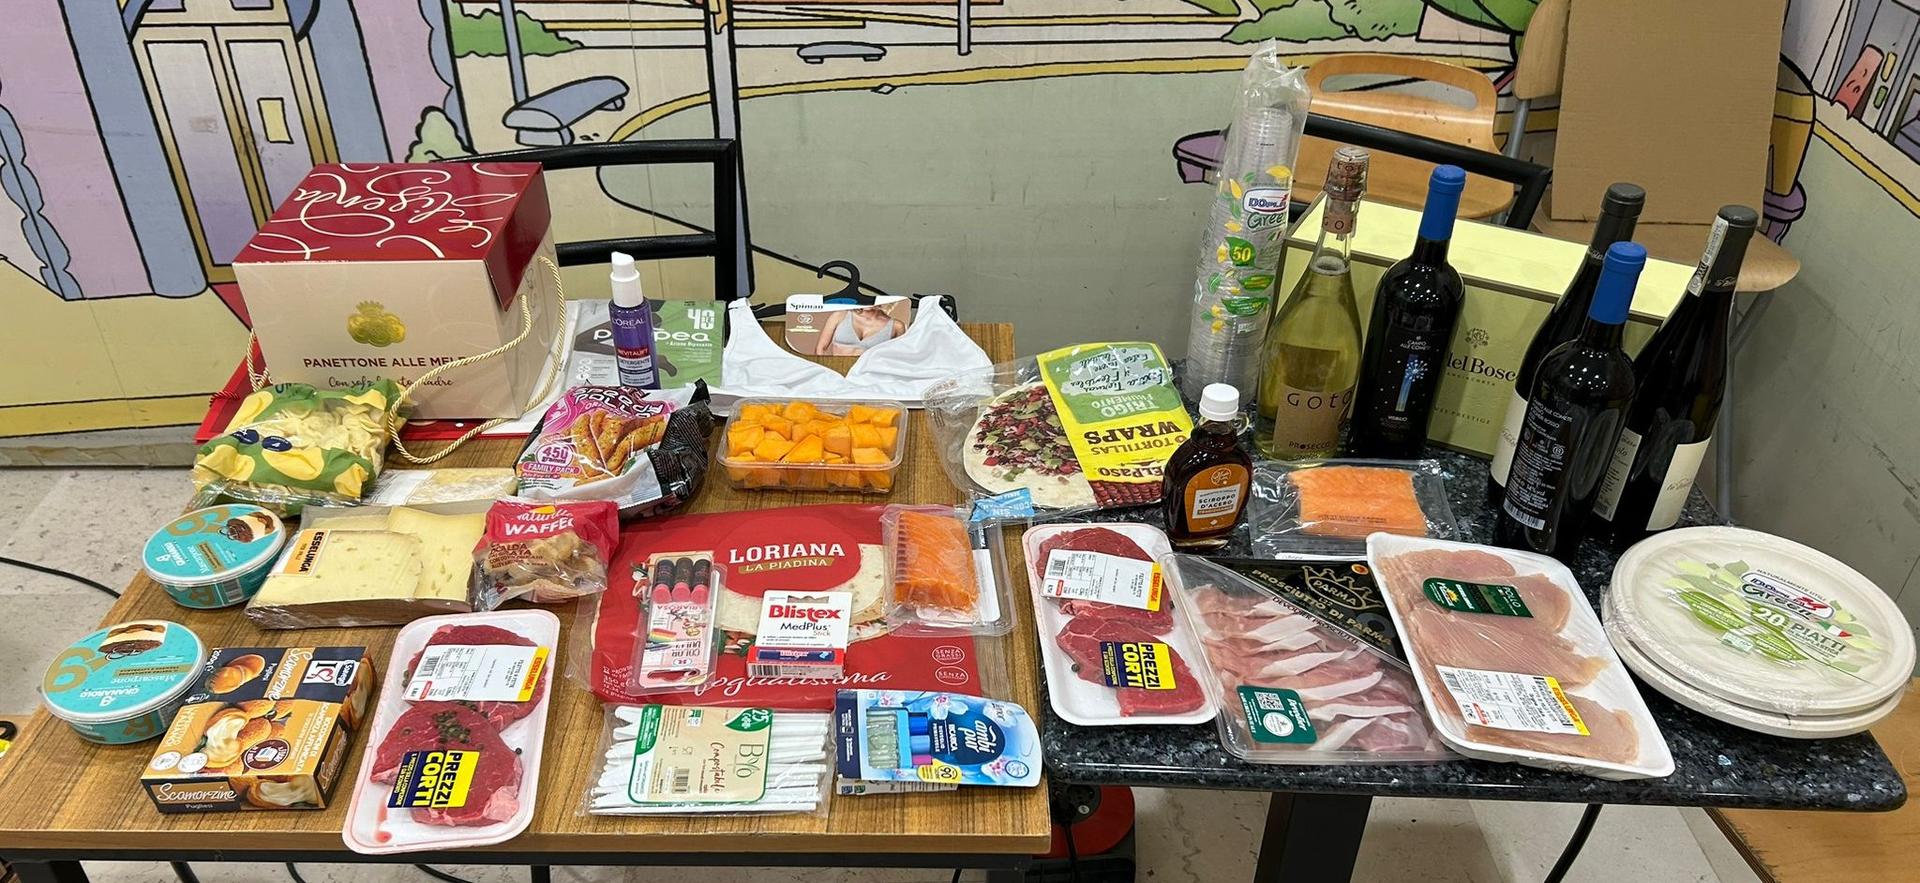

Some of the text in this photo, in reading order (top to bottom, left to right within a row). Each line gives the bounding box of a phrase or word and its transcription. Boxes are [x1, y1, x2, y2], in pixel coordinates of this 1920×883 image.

[1232, 247, 1252, 262] 50
[303, 358, 388, 368] PANETTONE
[392, 357, 427, 367] ALLE
[1092, 394, 1153, 409] FRUMENTO
[1101, 401, 1160, 417] TRIGO
[1084, 421, 1183, 445] WRAPS
[542, 445, 569, 459] 450
[1092, 438, 1173, 456] TORTILLAS
[1289, 440, 1330, 451] PROSECCO
[528, 463, 575, 474] FAMILY PACK
[1199, 494, 1236, 504] SCIROPPO
[1200, 500, 1233, 508] D'ACERO
[299, 531, 325, 572] ESSELUNGA
[729, 543, 846, 564] LORIANA
[745, 559, 828, 572] LA PIADINA
[1151, 572, 1161, 603] ESSELUNGA
[1313, 580, 1357, 606] PARMA
[1502, 586, 1522, 608] POLLO
[1252, 569, 1393, 646] PROSCIUTTO DI PARMA
[1741, 583, 1813, 621] Green
[768, 605, 841, 622] Blistex
[780, 622, 828, 631] MedPlus
[1754, 607, 1785, 626] 20
[1789, 623, 1847, 652] PIATTI
[267, 648, 314, 702] Scamorzine
[1122, 643, 1144, 687] CORTI
[1140, 644, 1160, 688] PREZZI
[111, 675, 177, 684] Mascarpone
[80, 688, 140, 698] GRANAROLO
[752, 709, 768, 723] 25
[949, 724, 959, 751] RICARICA
[957, 726, 980, 753] pur
[974, 719, 996, 754] ambi
[412, 752, 444, 806] CORTI
[435, 752, 463, 806] PREZZI
[941, 766, 952, 778] 90
[156, 782, 238, 803] Scamorzine
